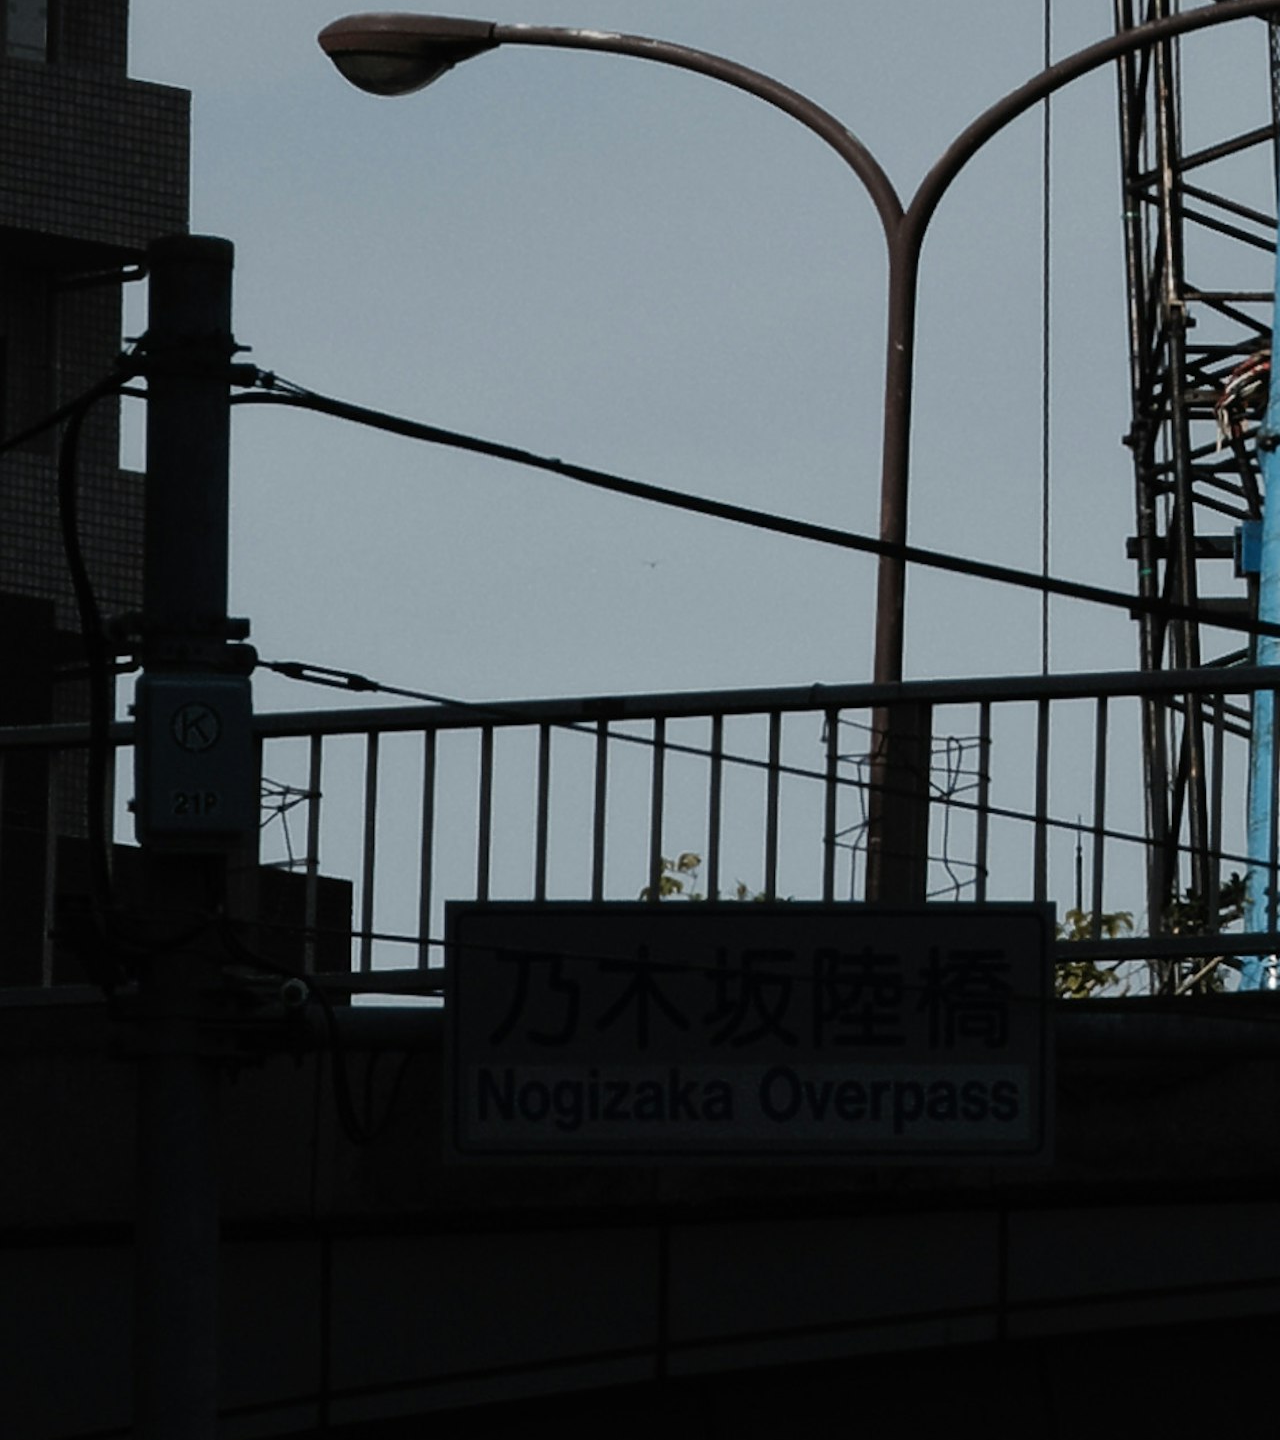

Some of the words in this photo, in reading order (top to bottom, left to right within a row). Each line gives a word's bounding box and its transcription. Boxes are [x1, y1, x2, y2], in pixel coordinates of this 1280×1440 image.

[489, 944, 1013, 1050] 乃木坂陸橋
[477, 1068, 733, 1132] Nogizaka
[759, 1066, 1019, 1134] Overpass
